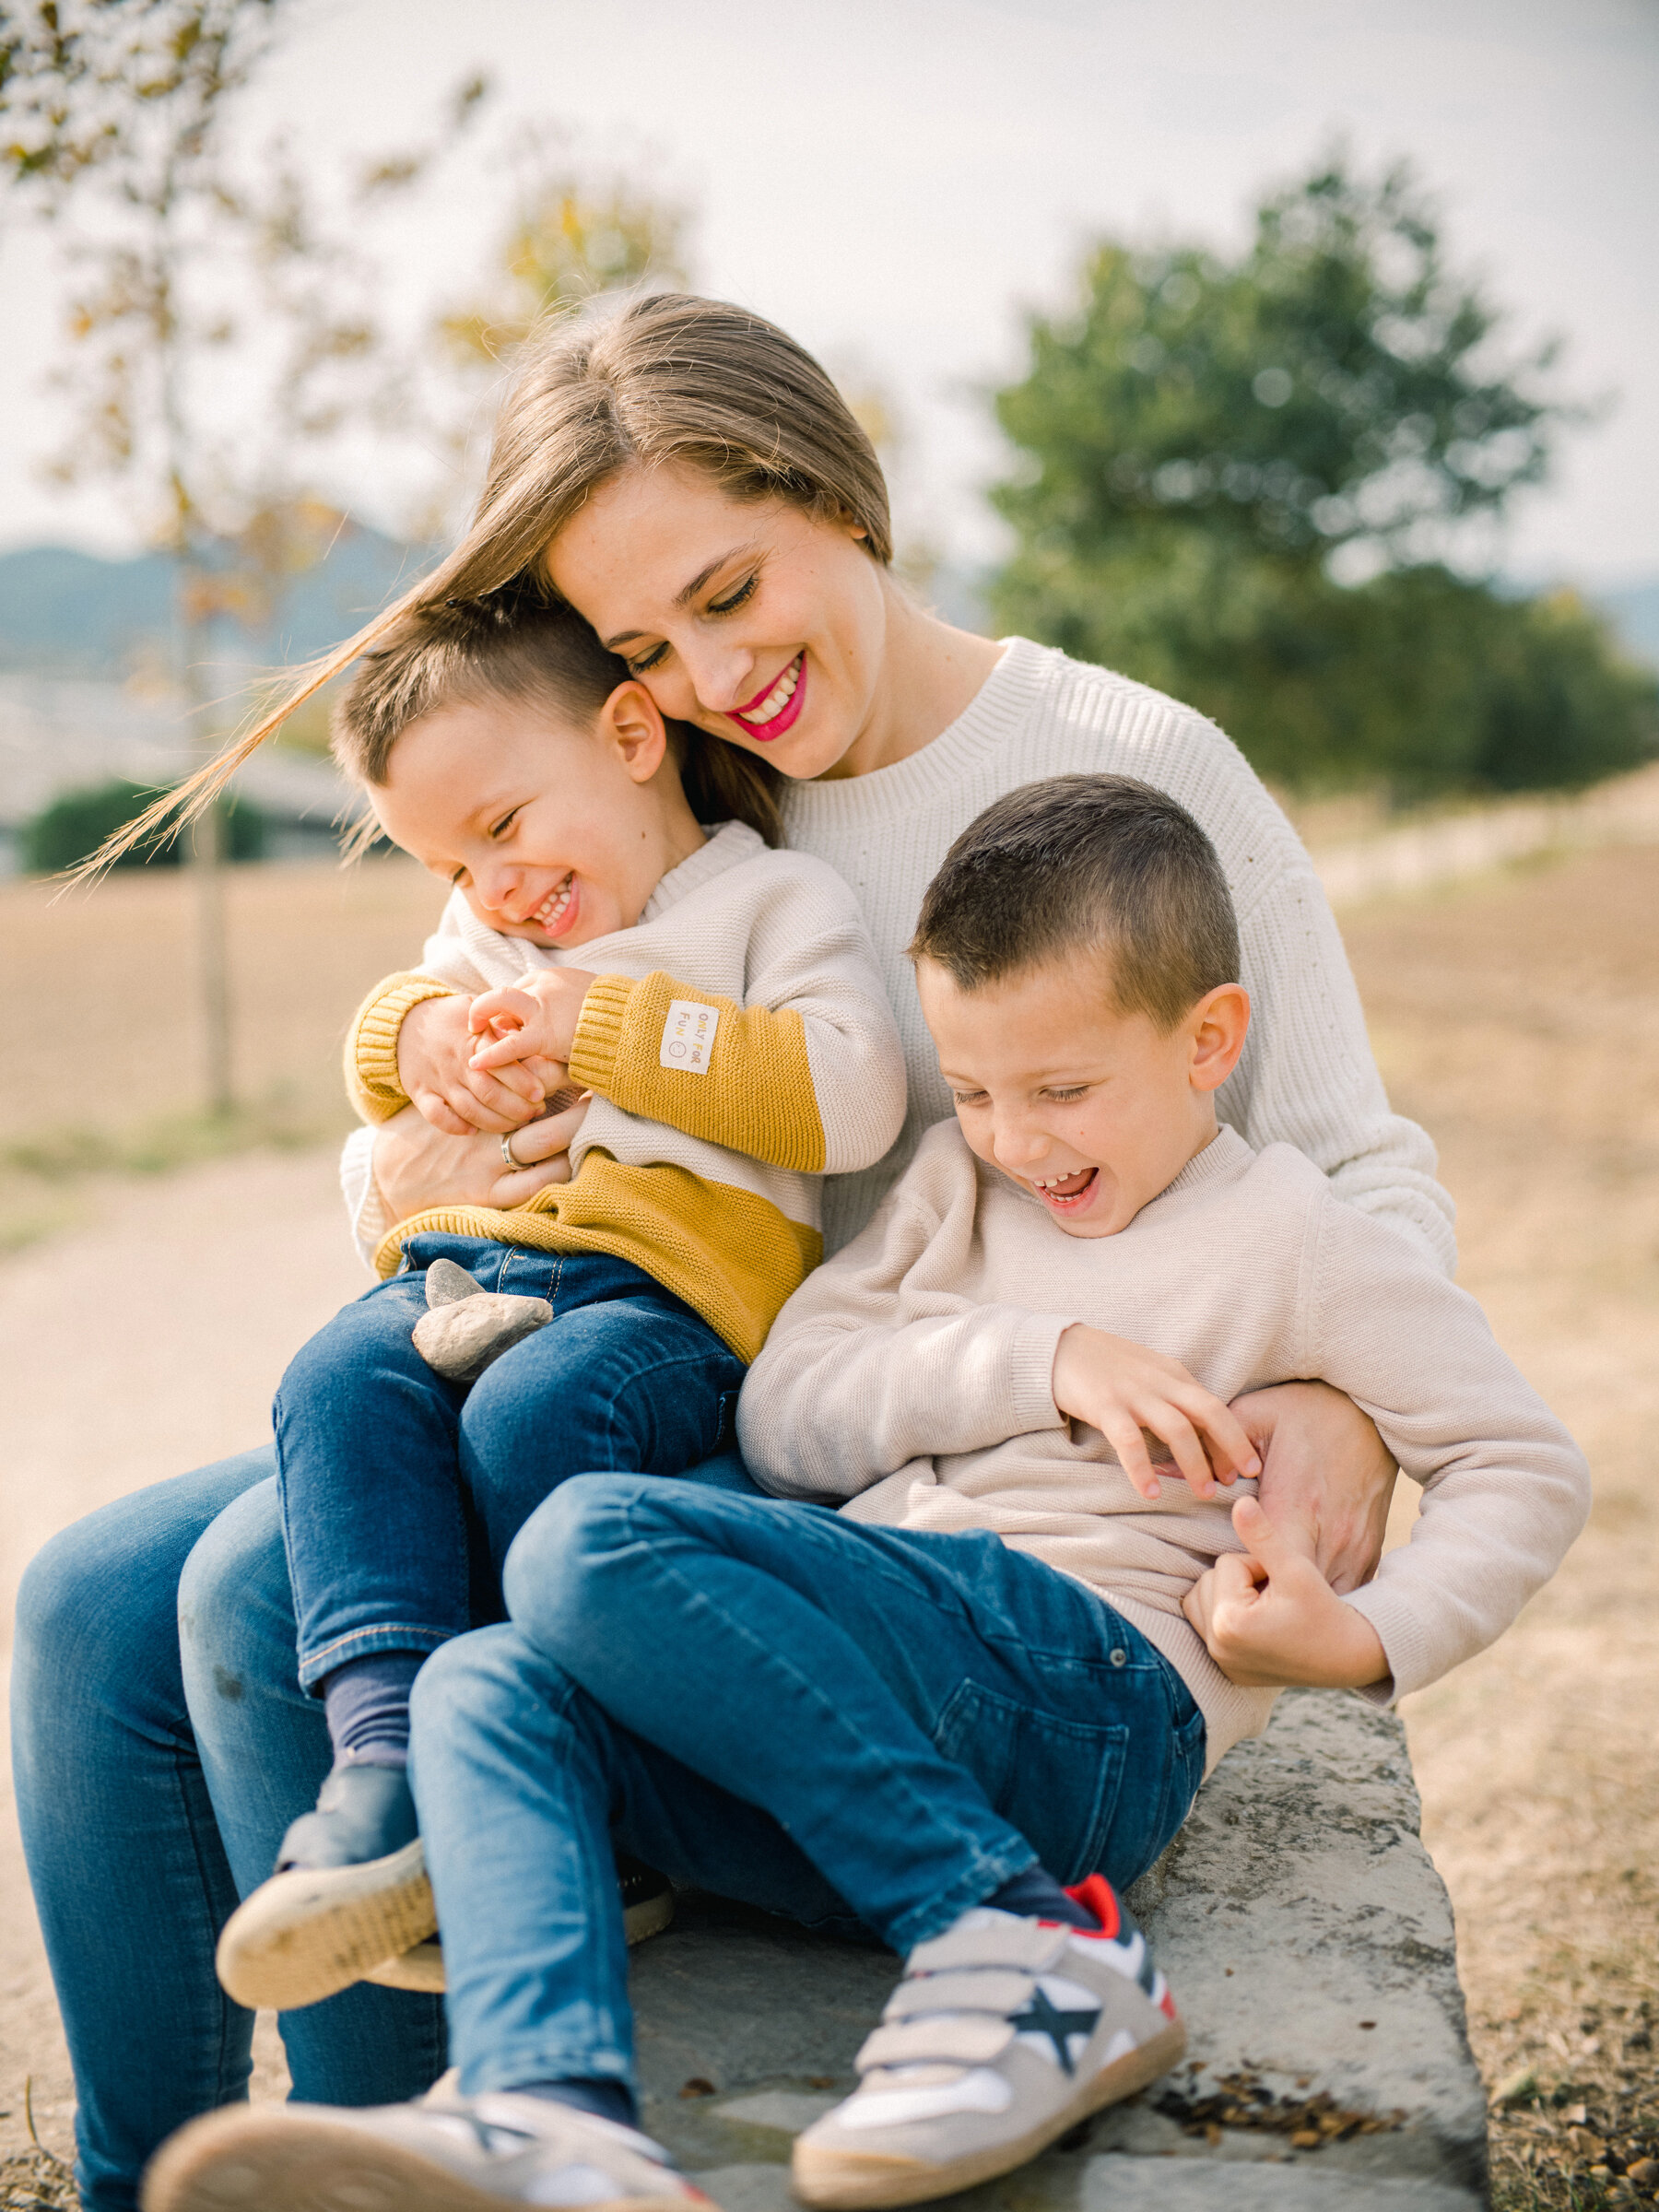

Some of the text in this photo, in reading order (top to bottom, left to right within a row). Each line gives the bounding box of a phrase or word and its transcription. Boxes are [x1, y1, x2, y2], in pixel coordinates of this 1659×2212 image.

[676, 1012, 690, 1036] FUN
[690, 1013, 709, 1064] ONLY FOR
